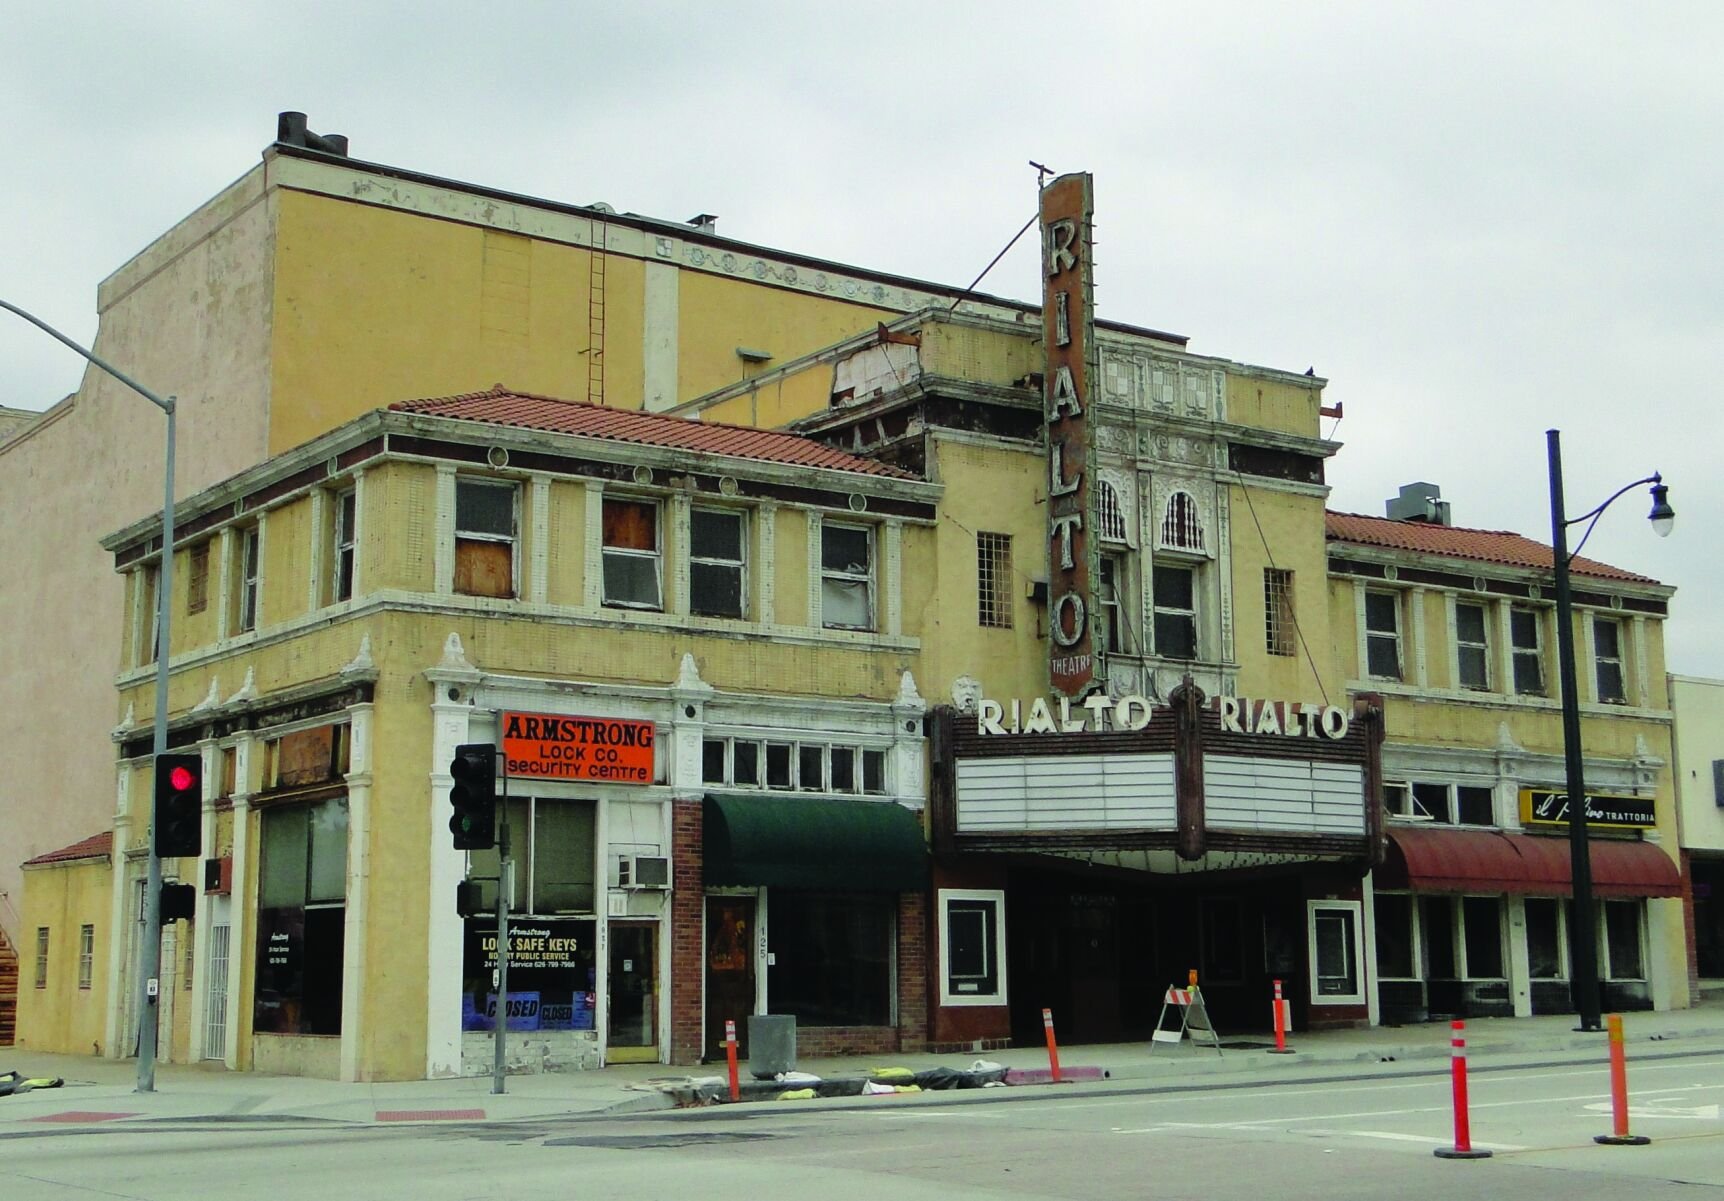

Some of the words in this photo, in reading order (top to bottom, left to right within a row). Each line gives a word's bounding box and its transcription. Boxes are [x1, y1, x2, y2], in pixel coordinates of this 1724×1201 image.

[1048, 219, 1086, 647] RIALTO
[978, 695, 1152, 735] RIALTO
[1220, 696, 1348, 739] RIALTO
[504, 716, 653, 748] ARMSTRONG
[540, 744, 586, 760] LOCK
[595, 748, 623, 763] CO.
[1606, 812, 1655, 822] TRATTORIA
[508, 926, 551, 939] Armstrong
[482, 937, 512, 951] LOK
[516, 938, 545, 951] SAFE
[549, 938, 577, 952] KEYS
[488, 952, 514, 960] NORY
[516, 952, 540, 960] PUBLIC
[541, 952, 570, 961] SERVICE
[488, 1000, 538, 1018] COSED
[542, 1006, 573, 1020] CLOSED
